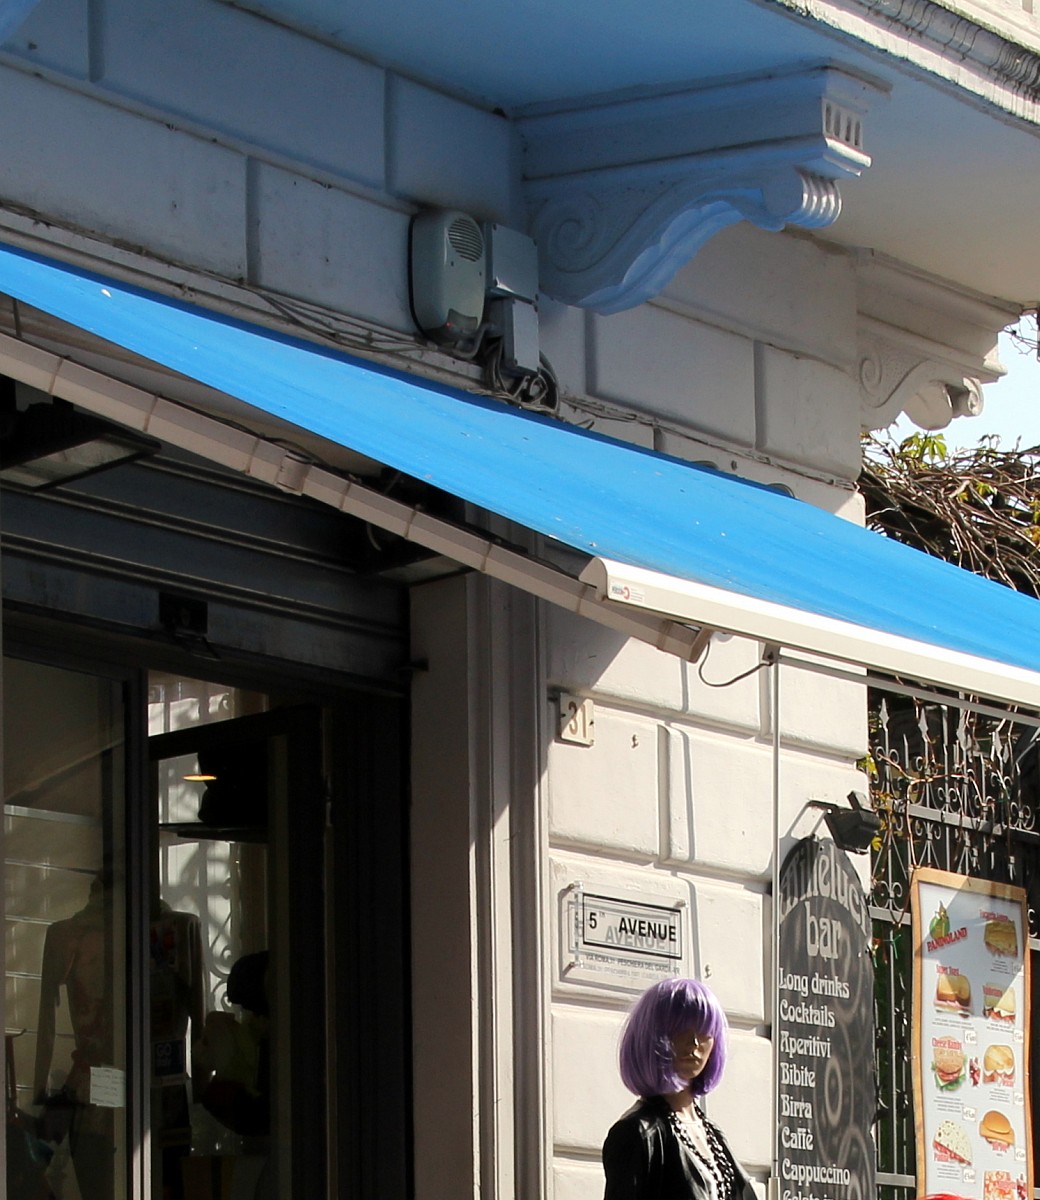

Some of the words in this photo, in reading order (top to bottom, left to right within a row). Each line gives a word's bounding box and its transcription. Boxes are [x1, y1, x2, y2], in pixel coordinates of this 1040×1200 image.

[568, 700, 587, 740] 31
[619, 917, 677, 942] AVENUE
[805, 900, 842, 960] bar
[779, 967, 809, 997] Long
[811, 972, 850, 999] drinks
[780, 999, 836, 1028] Cocktails
[780, 1030, 831, 1058] Aperitivi
[780, 1062, 816, 1088] Bibite
[780, 1094, 812, 1119] Birra
[781, 1126, 814, 1151] Caffè
[782, 1158, 851, 1187] Cappuccino
